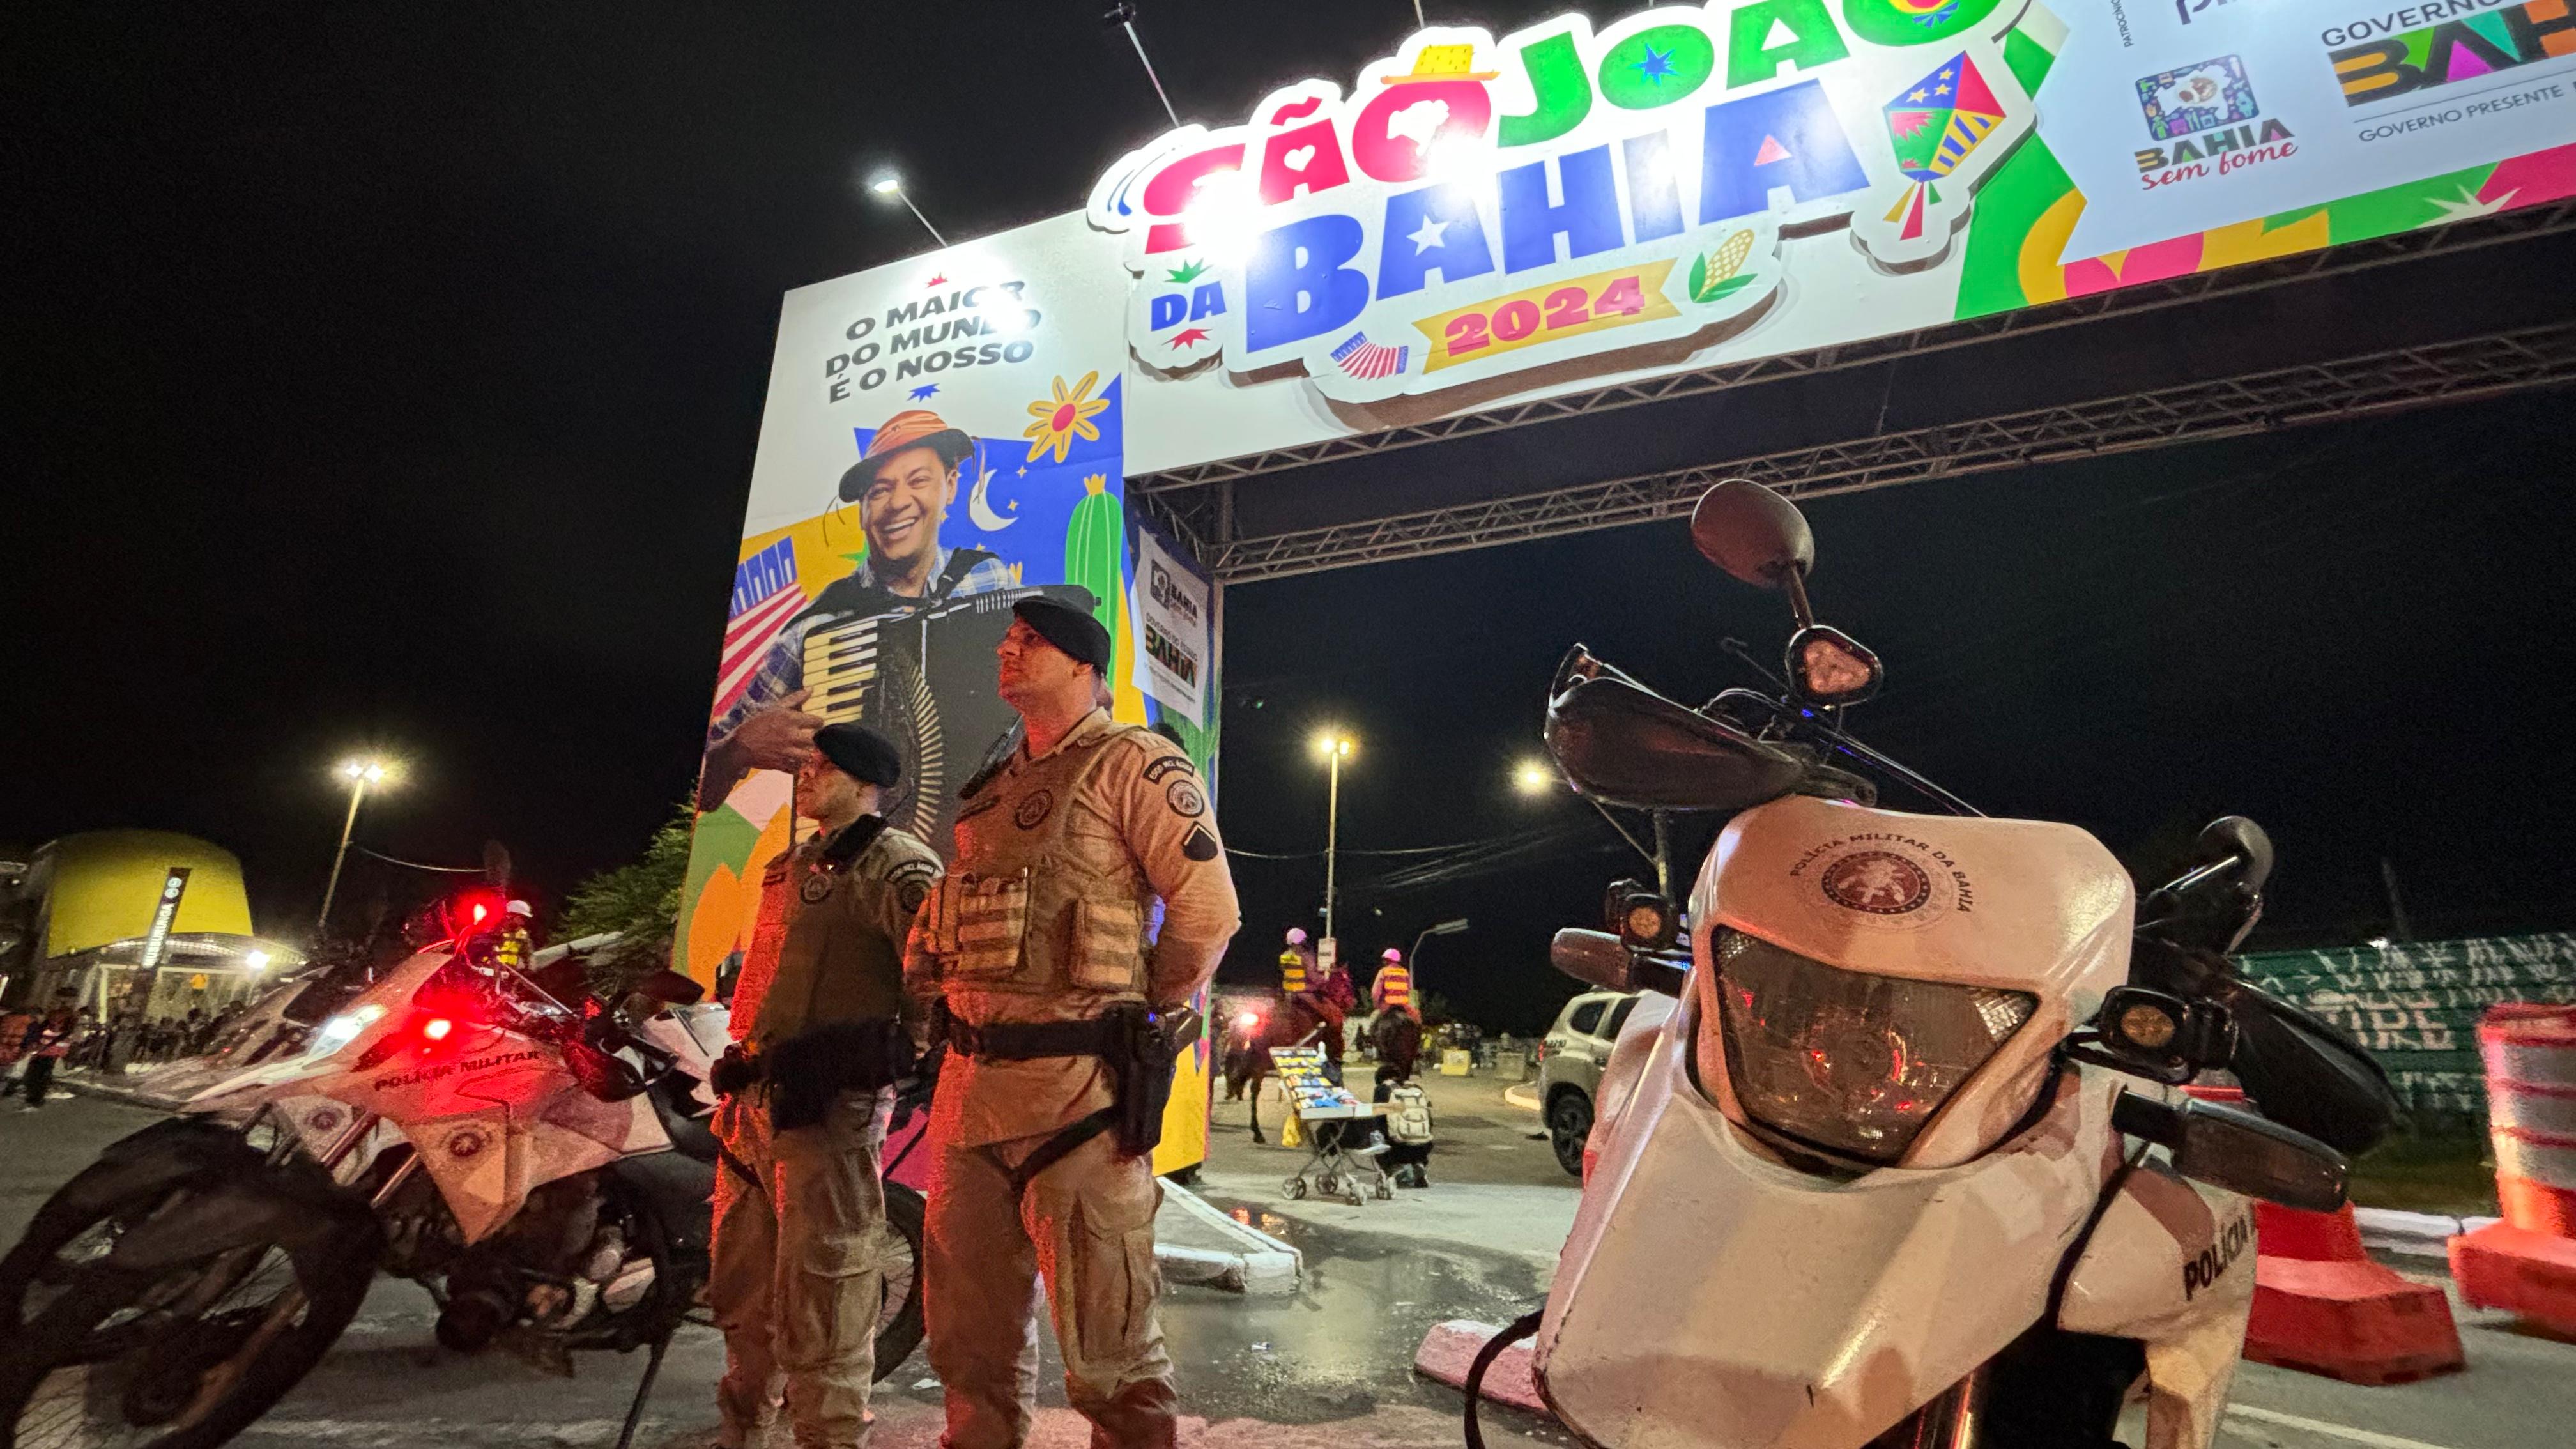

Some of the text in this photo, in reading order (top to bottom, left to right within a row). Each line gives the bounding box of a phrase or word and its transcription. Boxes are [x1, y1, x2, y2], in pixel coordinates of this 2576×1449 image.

[2321, 0, 2500, 47] GOVERN
[2359, 84, 2564, 142] GOVERNO PRESENTE
[2134, 118, 2295, 173] BAHIA
[2142, 142, 2299, 190] sem fome
[1151, 78, 1871, 353] DA BAHIA
[846, 318, 876, 341] O
[1445, 275, 1646, 358] 2024
[825, 342, 880, 378] DO
[829, 340, 1034, 404] É O NOSSO
[1790, 833, 1974, 912] POLÍCIA MILITAR DA BAHIA
[460, 1051, 539, 1072] MILITAR
